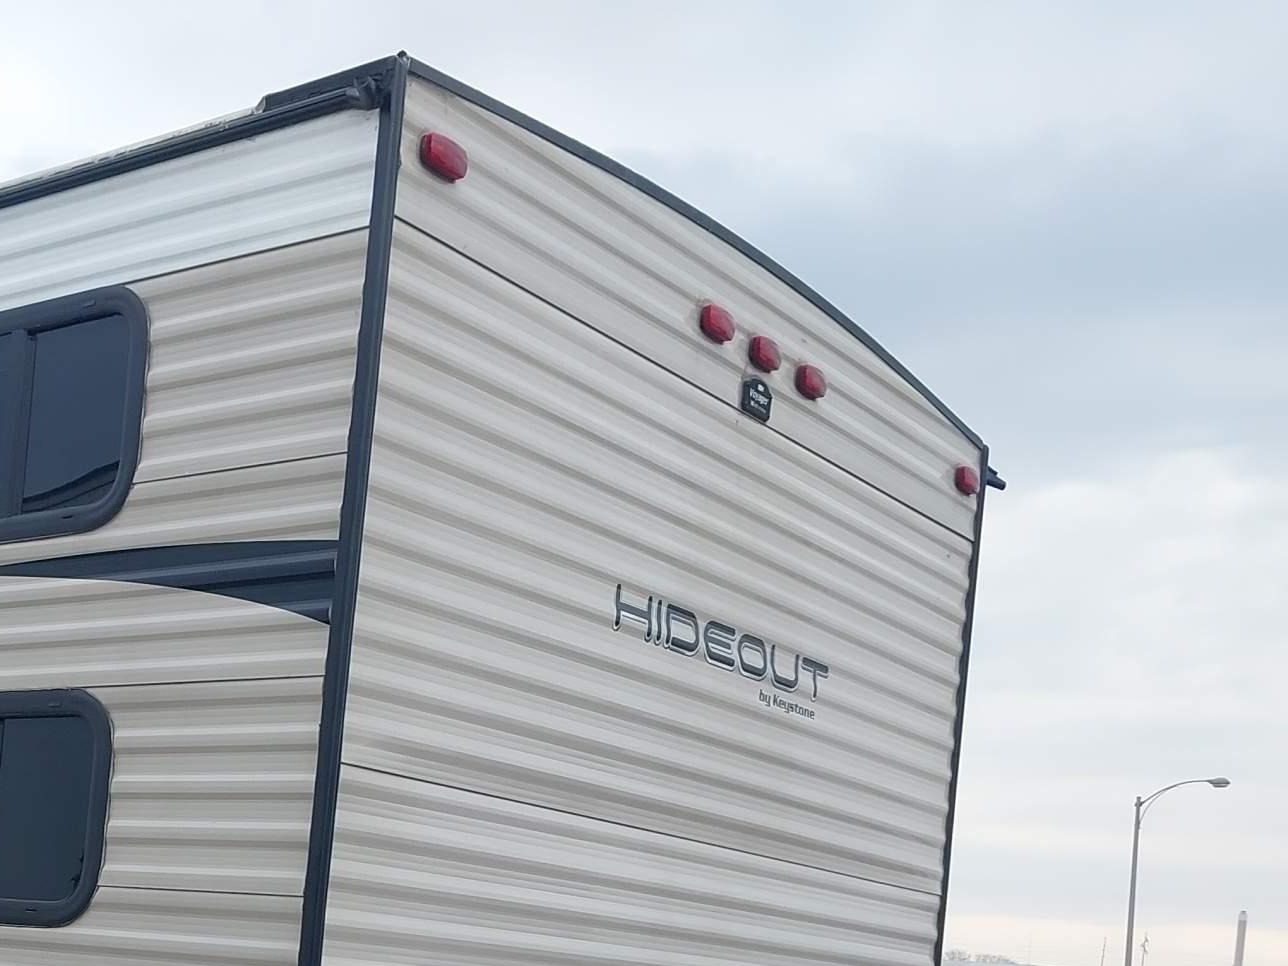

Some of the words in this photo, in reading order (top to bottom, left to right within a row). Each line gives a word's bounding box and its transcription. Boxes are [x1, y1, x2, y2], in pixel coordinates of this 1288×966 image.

[612, 583, 830, 702] HIDEOUT
[759, 689, 771, 707] by
[773, 694, 815, 720] Keystone
